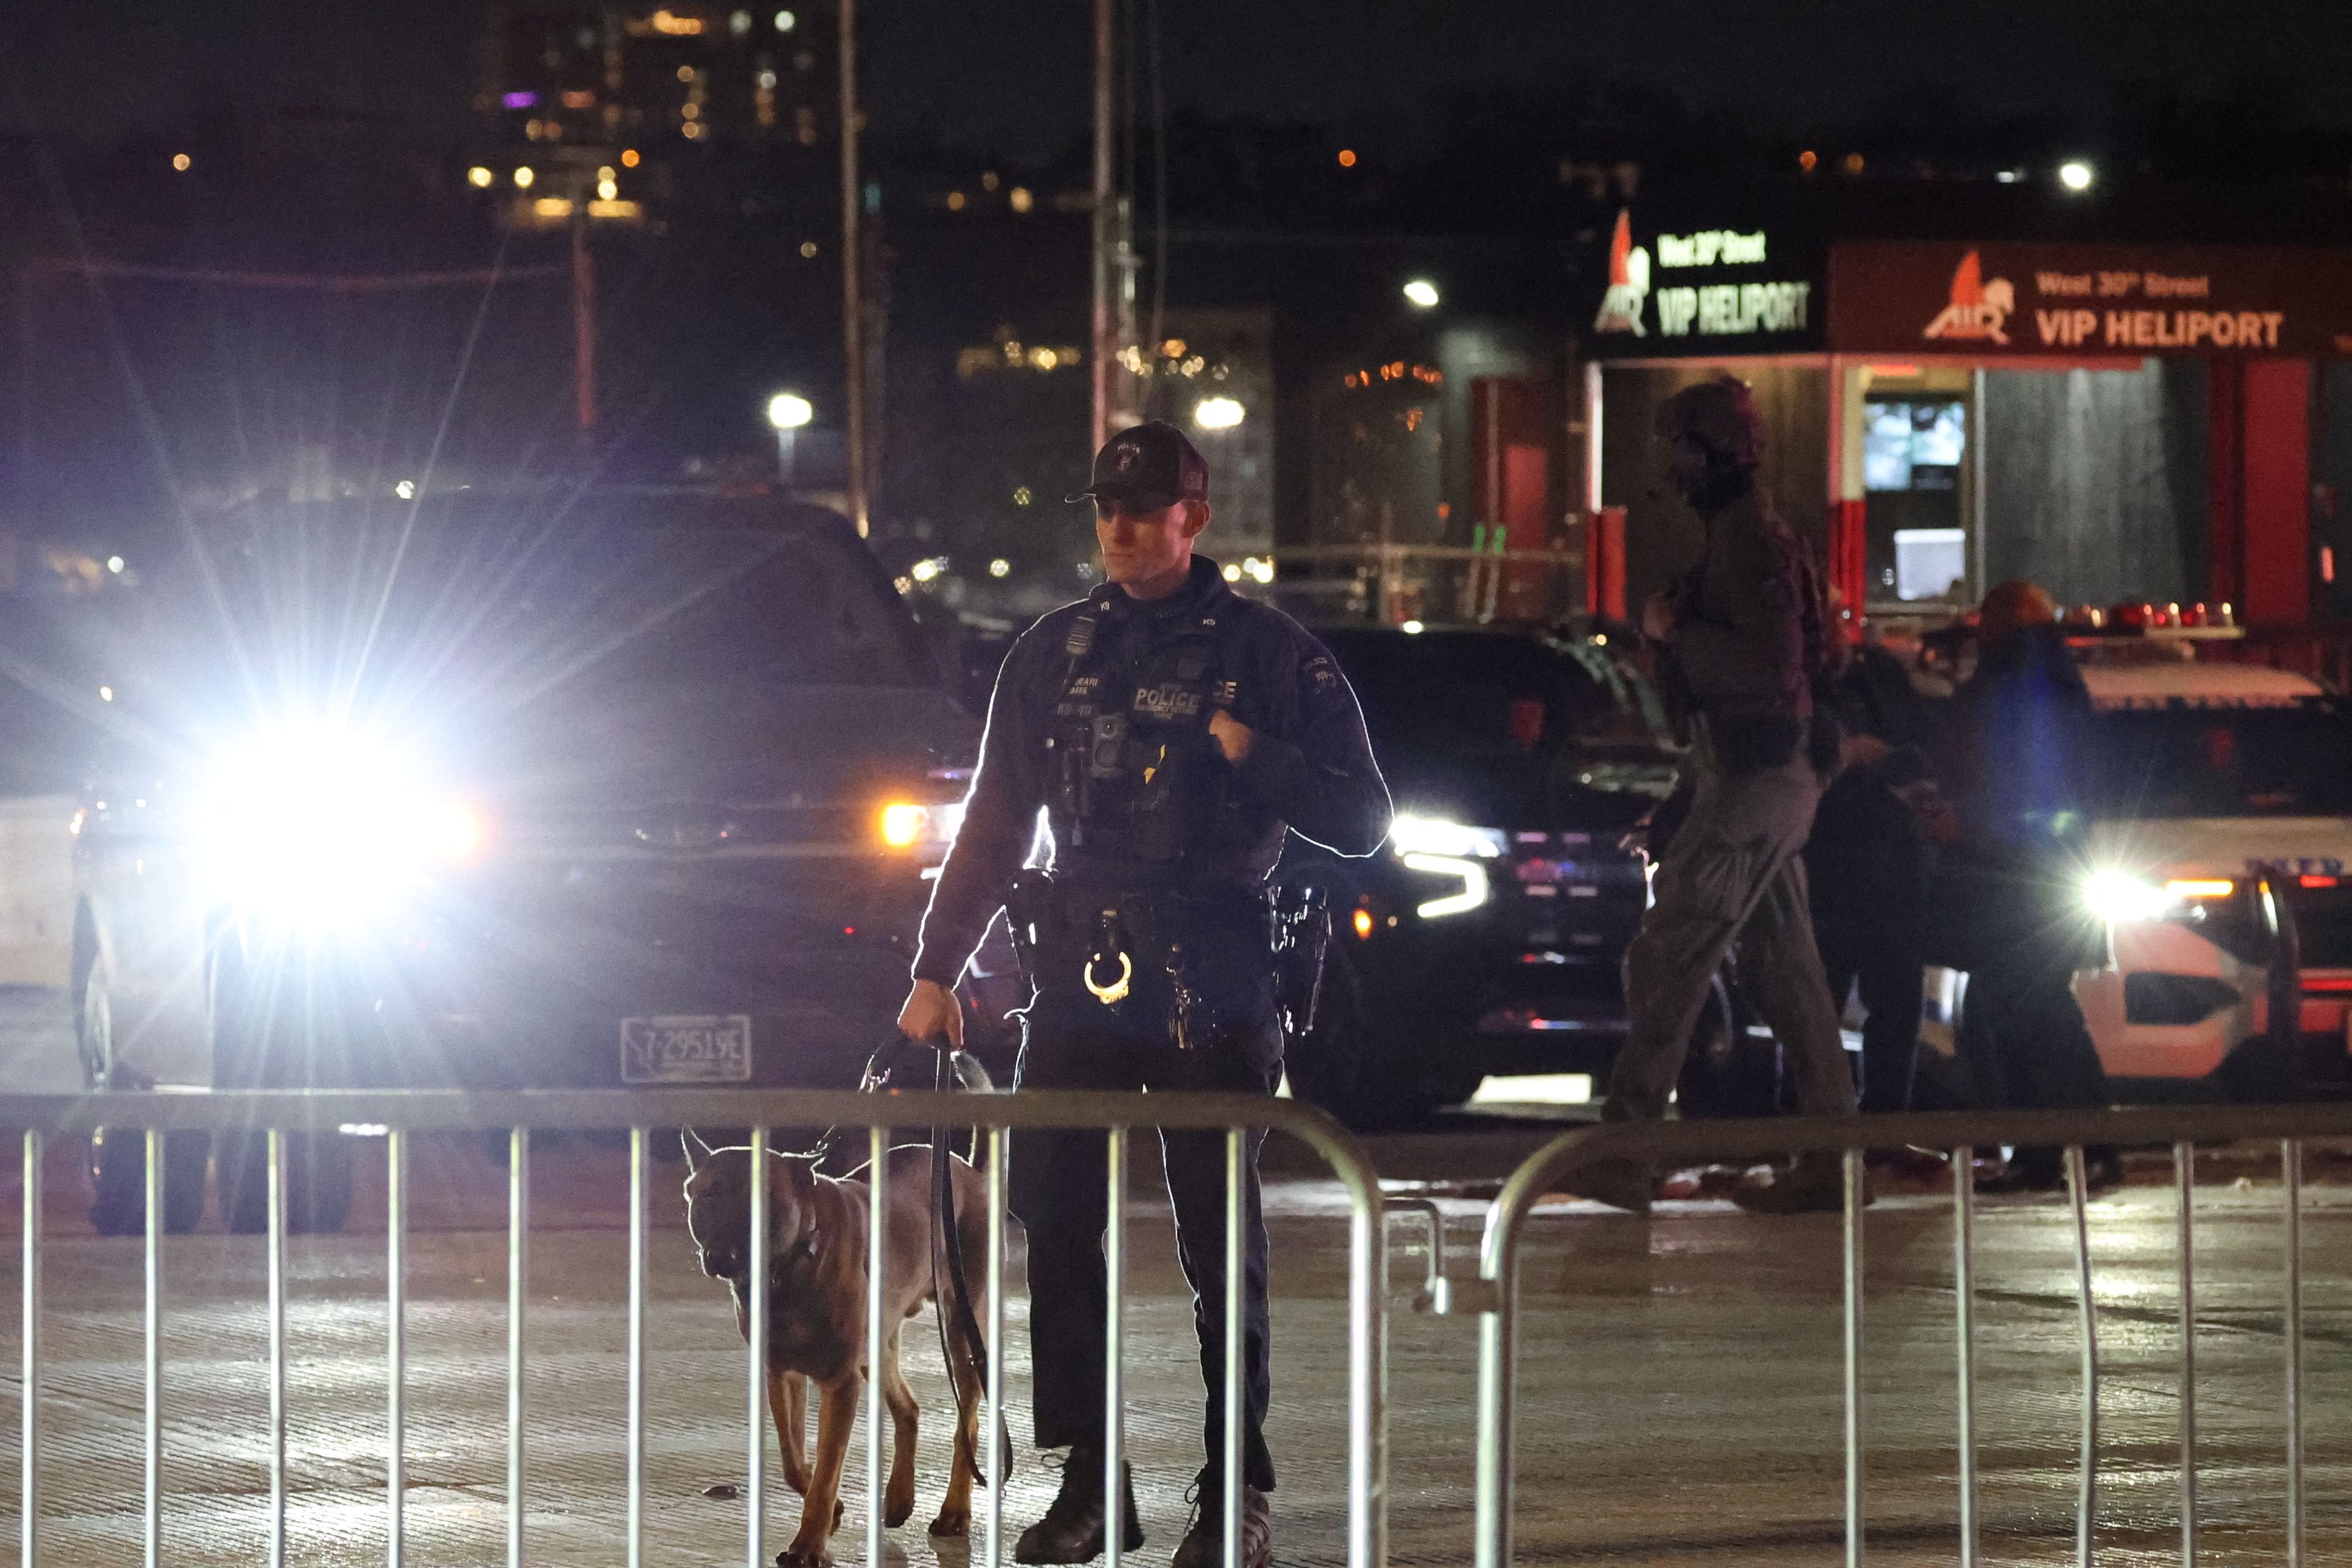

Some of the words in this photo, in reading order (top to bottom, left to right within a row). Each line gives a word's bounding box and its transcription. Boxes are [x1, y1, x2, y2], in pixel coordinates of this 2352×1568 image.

[2035, 271, 2093, 297] West
[1657, 286, 1697, 337] VIP
[1698, 281, 1811, 335] HELIPORT
[2035, 309, 2098, 346] VIP
[2104, 310, 2284, 348] HELIPORT
[1100, 601, 1110, 611] K9
[1135, 689, 1200, 707] POLICE
